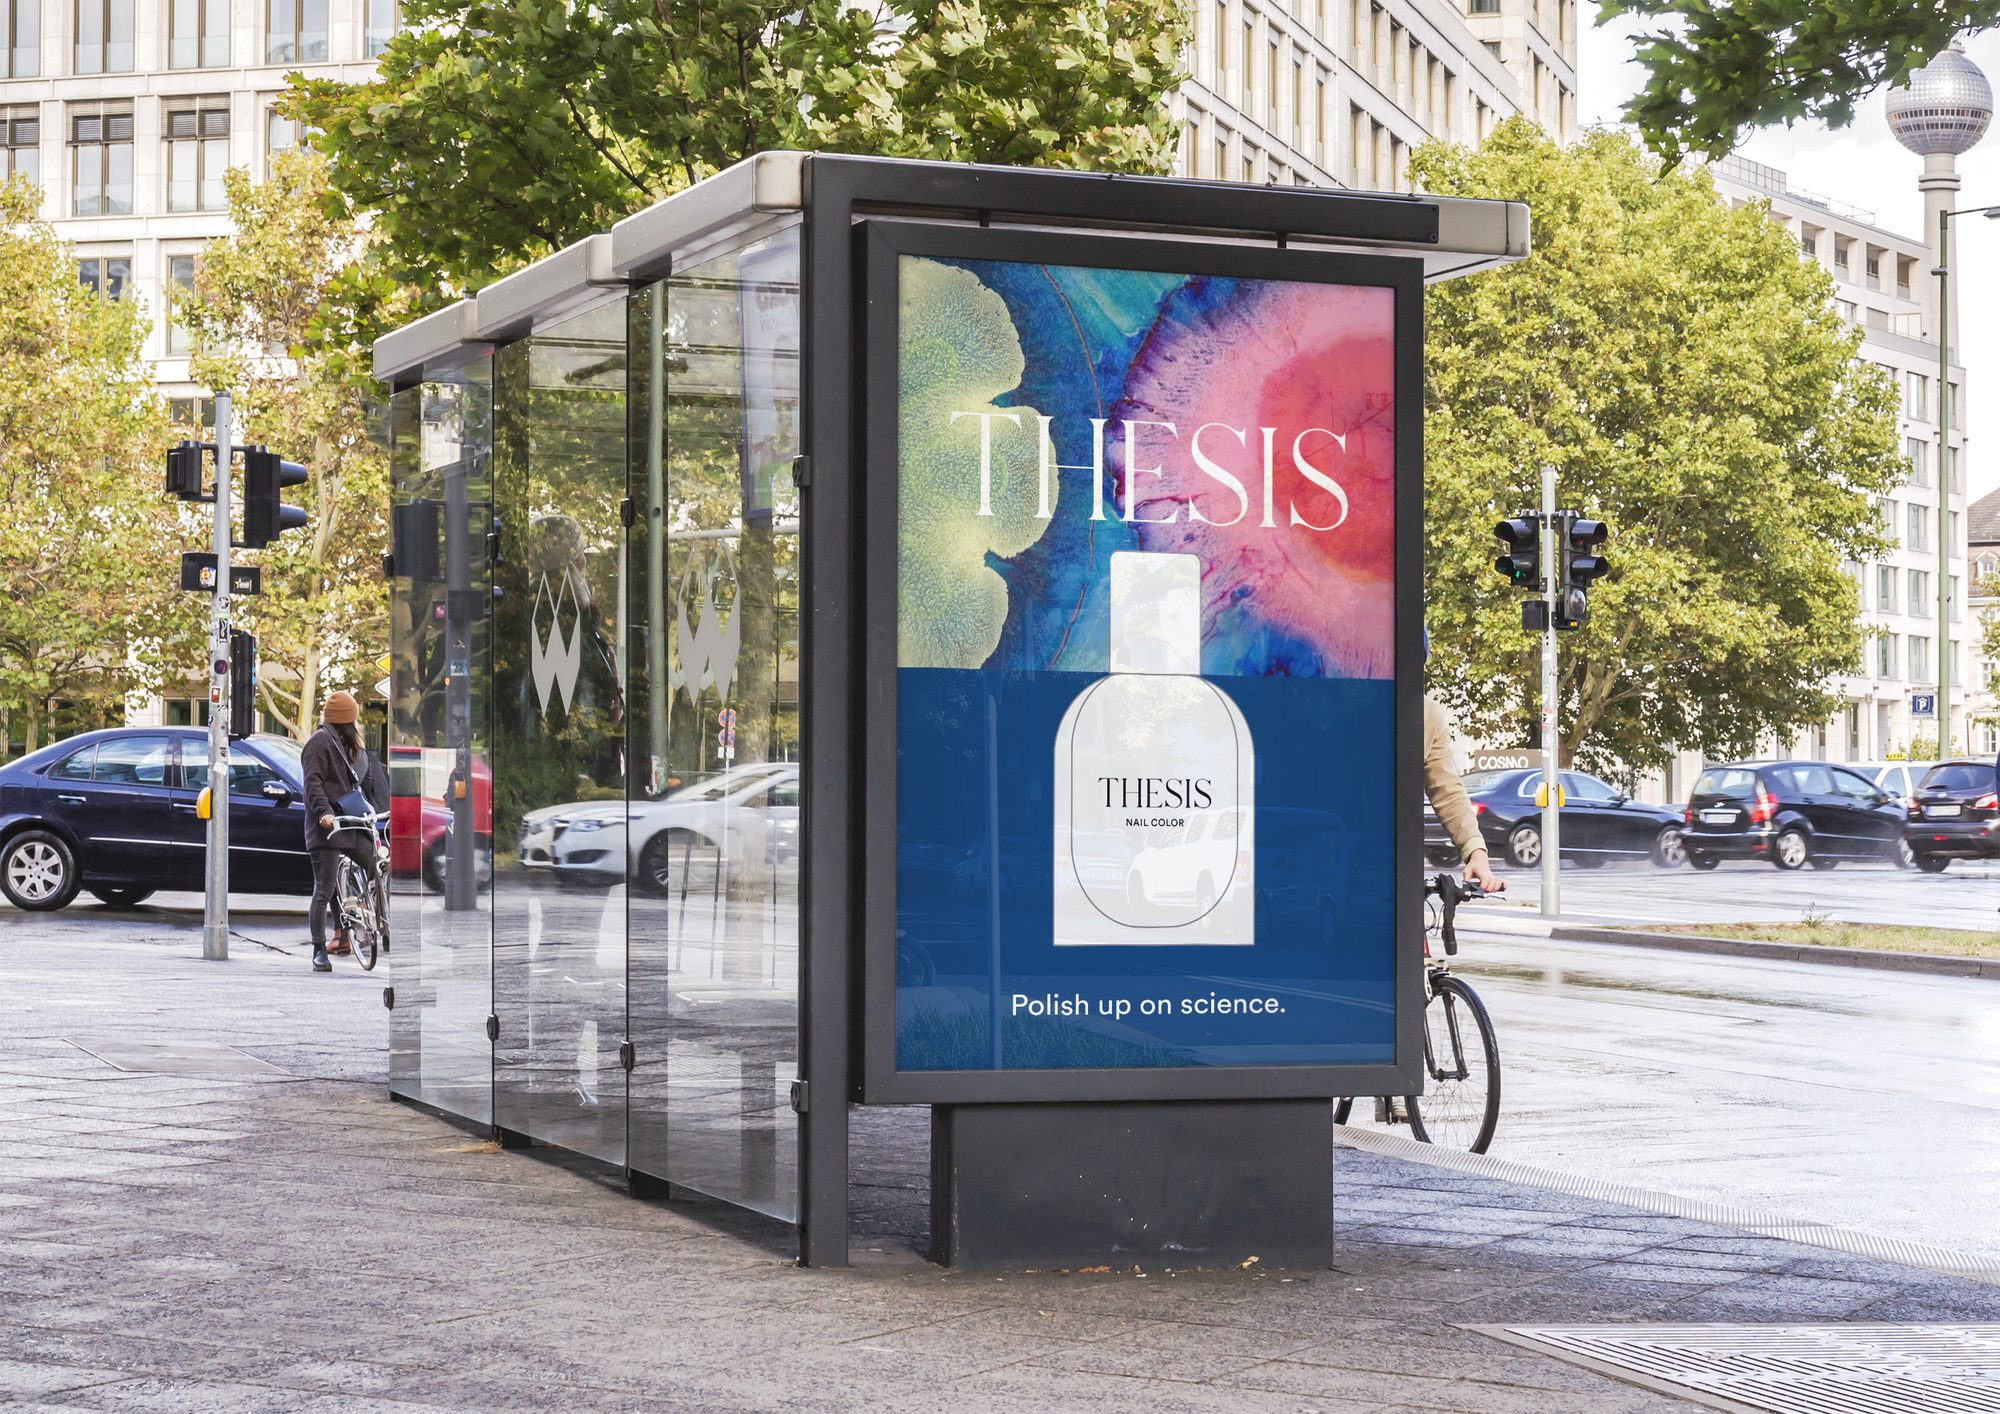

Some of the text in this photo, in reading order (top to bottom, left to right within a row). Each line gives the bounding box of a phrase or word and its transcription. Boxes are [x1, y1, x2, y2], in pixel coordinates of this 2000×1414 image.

[950, 410, 1350, 531] THESIS
[1478, 756, 1529, 770] COSMO
[1098, 777, 1212, 809] THESIS
[1125, 818, 1185, 827] NAIL COLOR
[1011, 991, 1286, 1020] Polish up on science.
